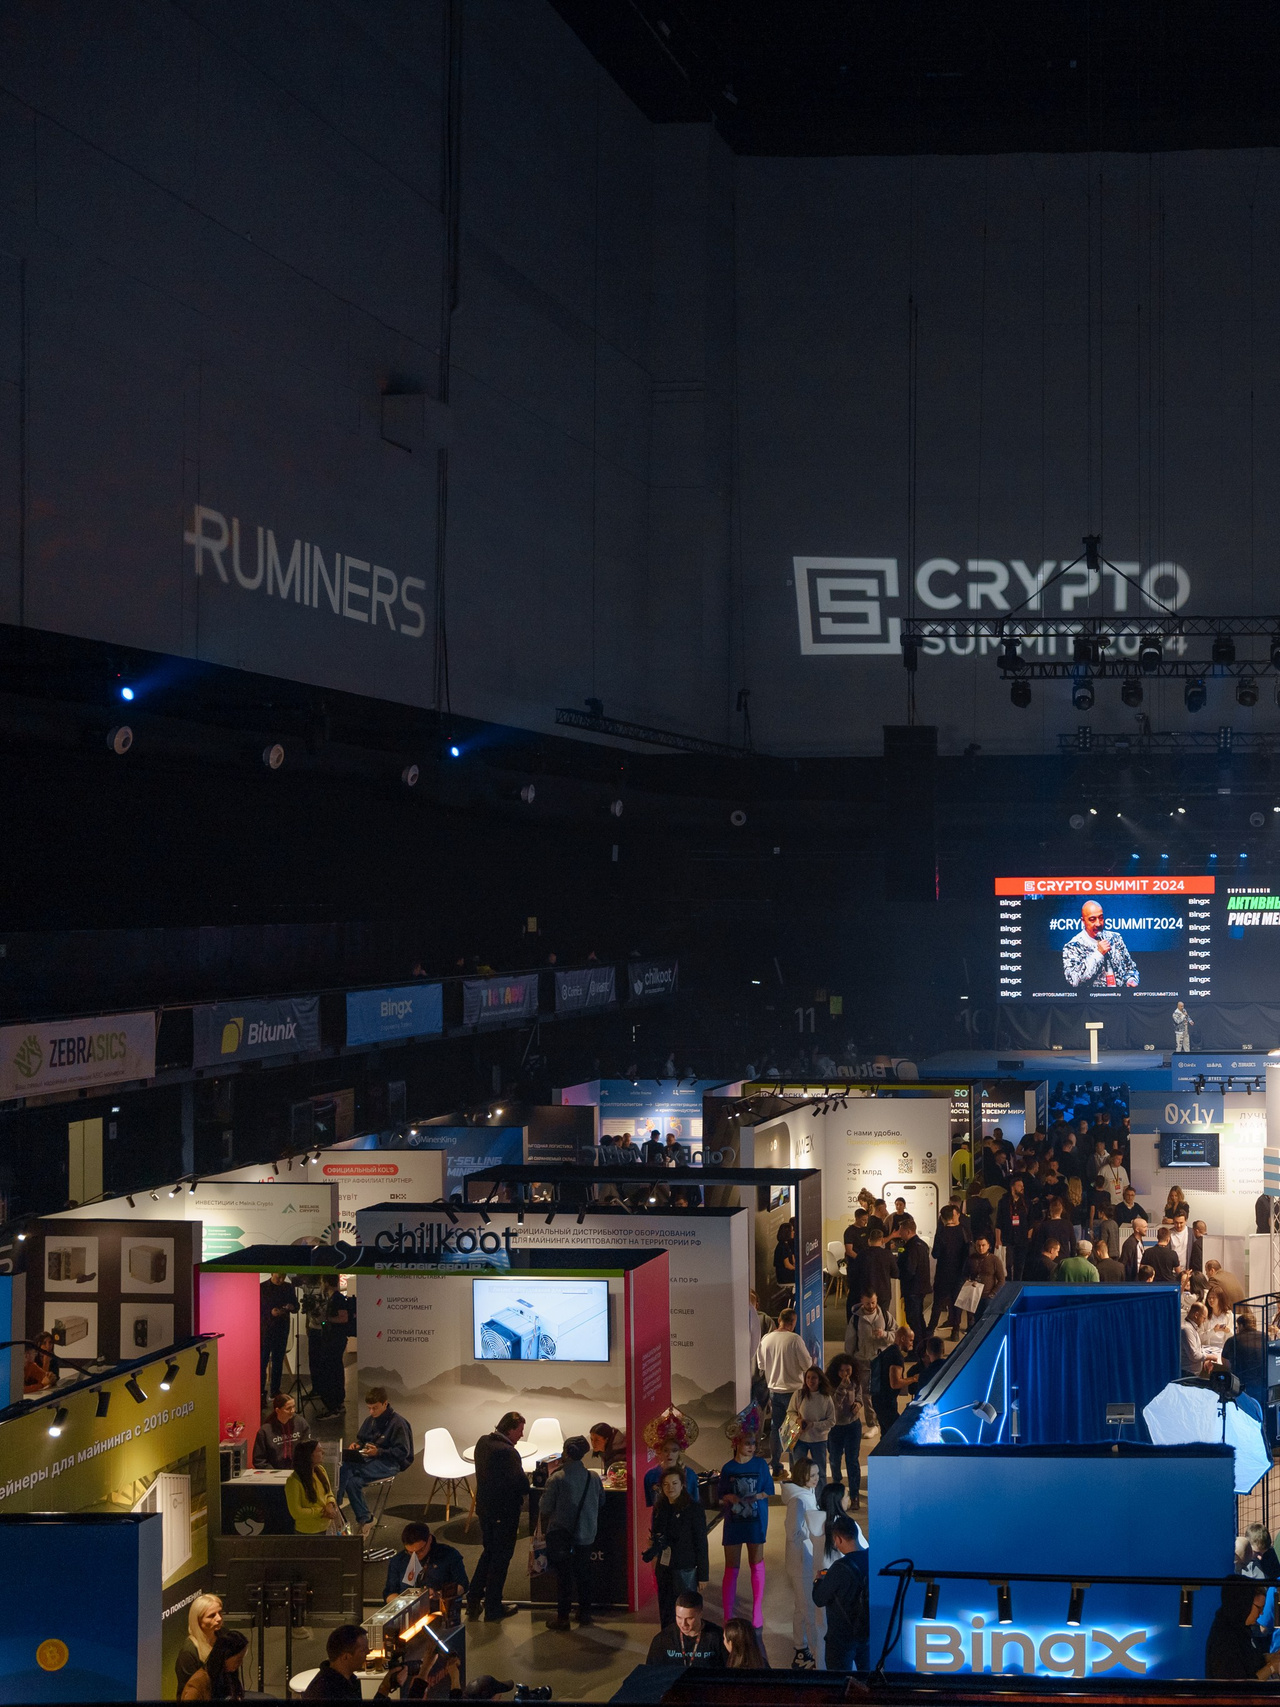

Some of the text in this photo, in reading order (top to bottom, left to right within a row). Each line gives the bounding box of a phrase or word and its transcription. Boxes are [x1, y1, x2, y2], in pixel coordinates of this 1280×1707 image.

[184, 504, 426, 638] RUMINERS
[914, 557, 1191, 613] CRYPTO
[1037, 880, 1185, 892] CRYPTO SUMMIT 2024
[1050, 918, 1184, 930] #CRYSUMMIT2024
[1228, 912, 1260, 926] РИСК
[794, 1007, 816, 1033] 11
[248, 1016, 296, 1044] Bitunix
[49, 1031, 126, 1068] ZEBRASICS
[954, 1089, 989, 1098] SOA
[874, 1130, 902, 1138] удобно.
[447, 1157, 502, 1166] T-SELLING
[342, 1210, 356, 1218] Bitg
[374, 1222, 520, 1255] chilkoot
[572, 1228, 633, 1237] ДИСТРИБЬЮТОР
[635, 1230, 695, 1238] ОБОРУДОВАНИЯ
[529, 1236, 570, 1245] МАЙНИНГА
[572, 1238, 627, 1246] КРИПТОВАЛЮТ
[374, 1263, 392, 1271] BY
[438, 1263, 480, 1272] GROUP
[387, 1296, 418, 1304] ШИРОКИЙ
[0, 1399, 194, 1500] ейнеры для майнинга с 2016 года
